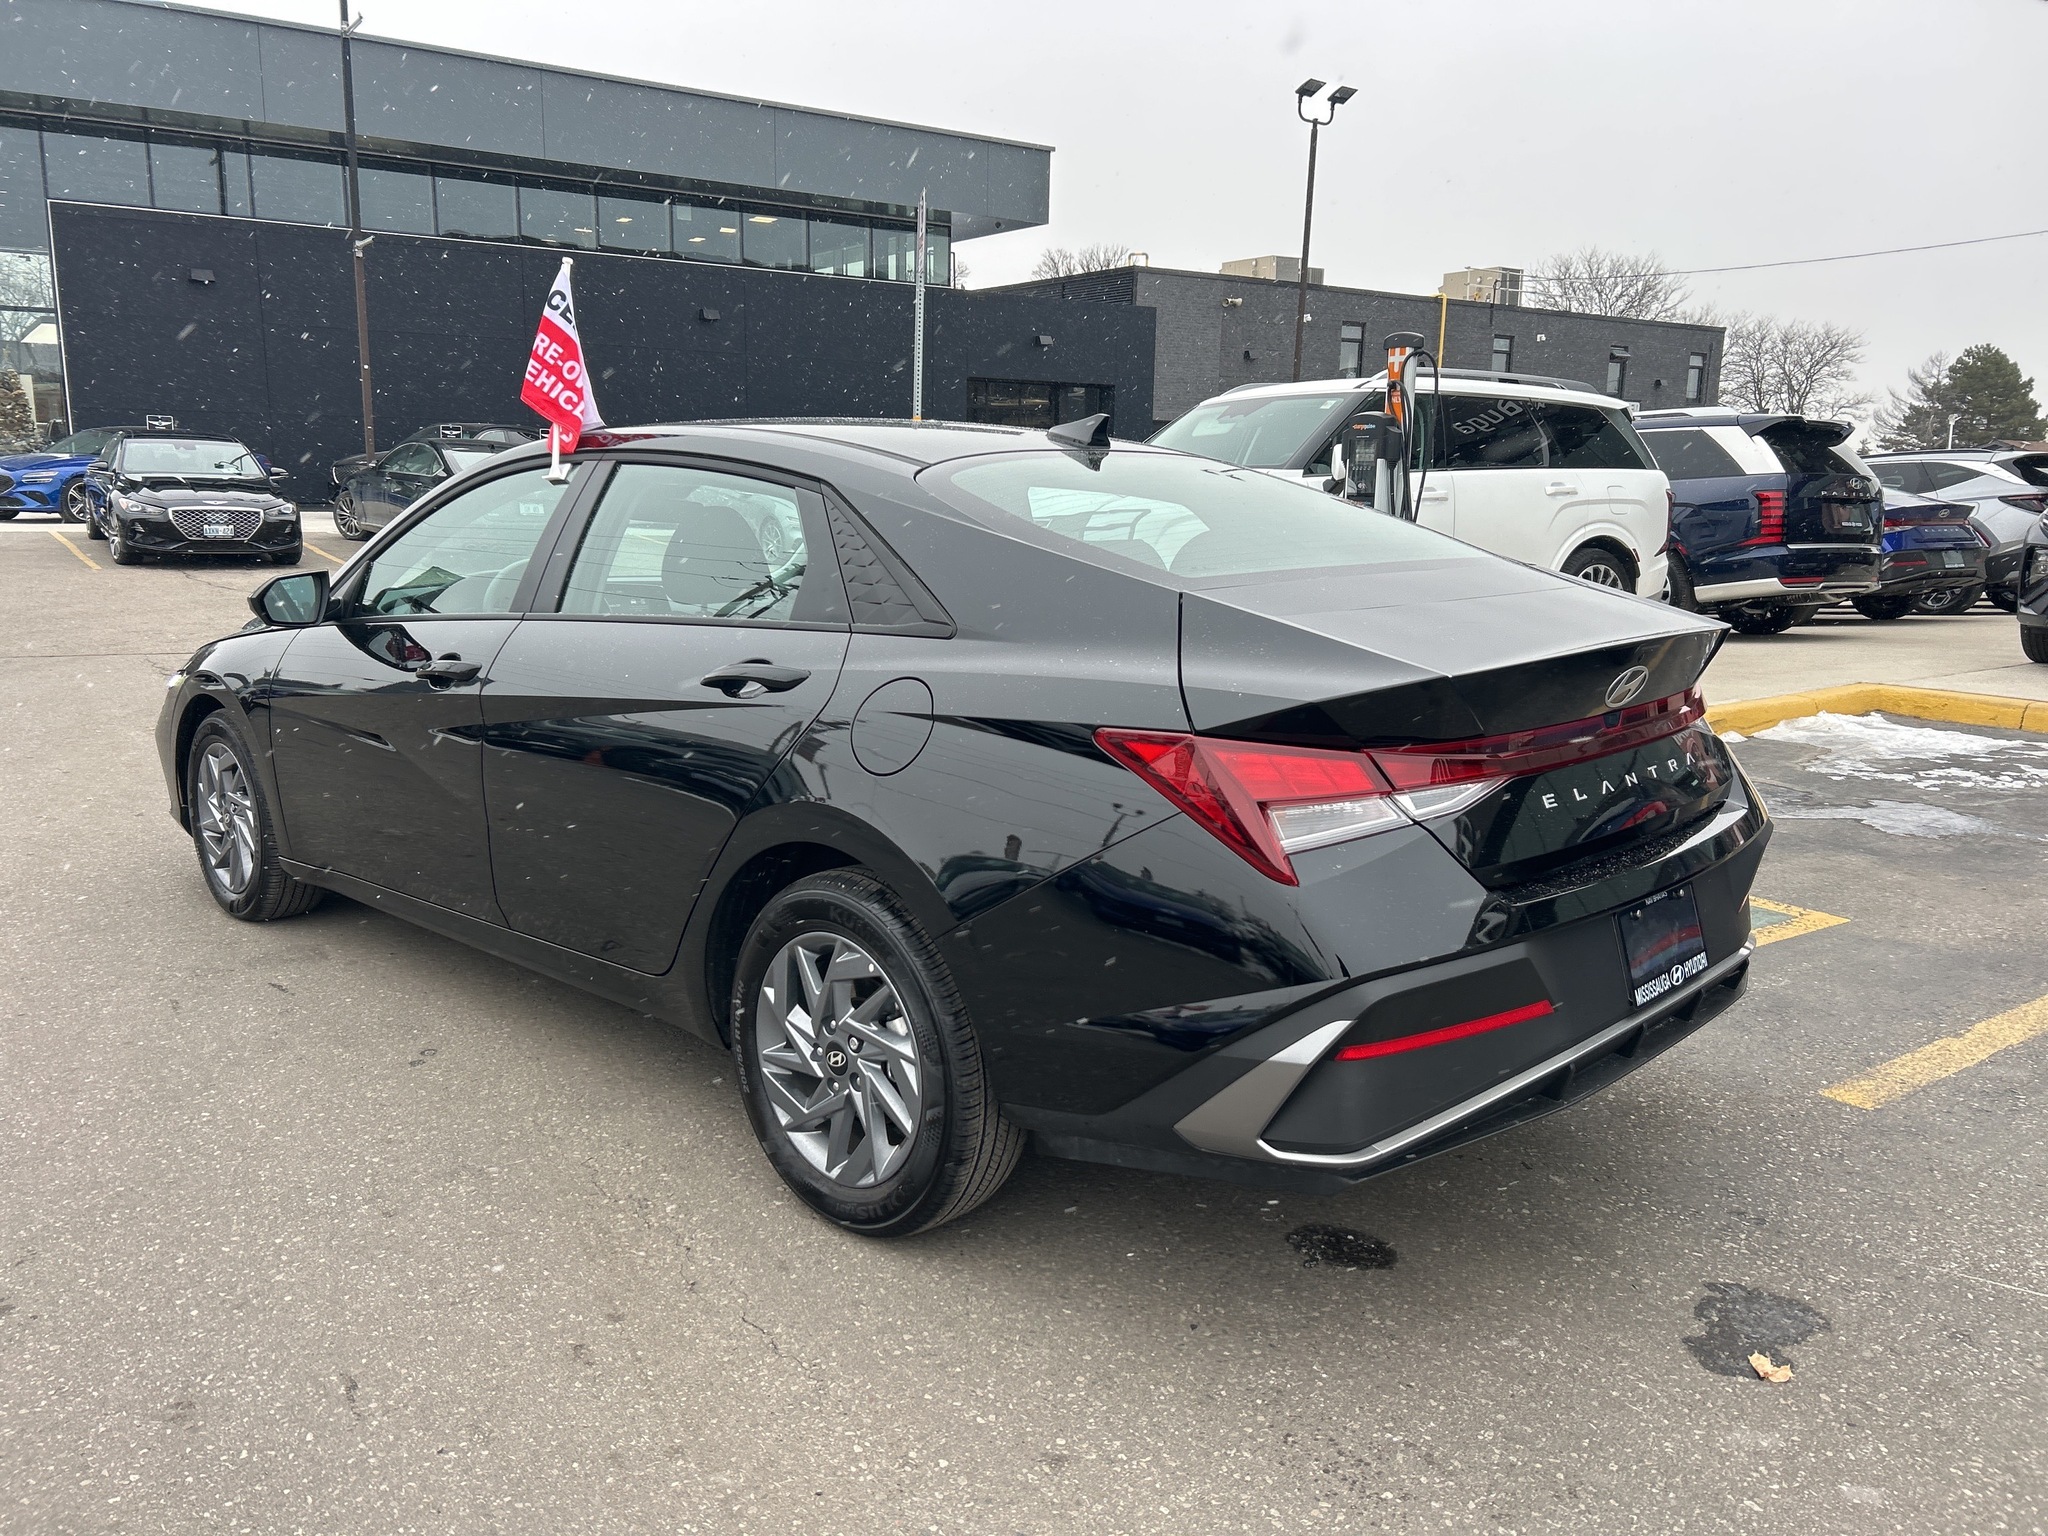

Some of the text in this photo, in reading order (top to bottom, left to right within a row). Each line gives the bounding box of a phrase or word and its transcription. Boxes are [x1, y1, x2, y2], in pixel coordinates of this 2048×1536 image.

[547, 289, 575, 328] CE
[1542, 751, 1696, 809] ELANTRA
[1634, 951, 1709, 1007] MISSISSAUGA HYUNDAI
